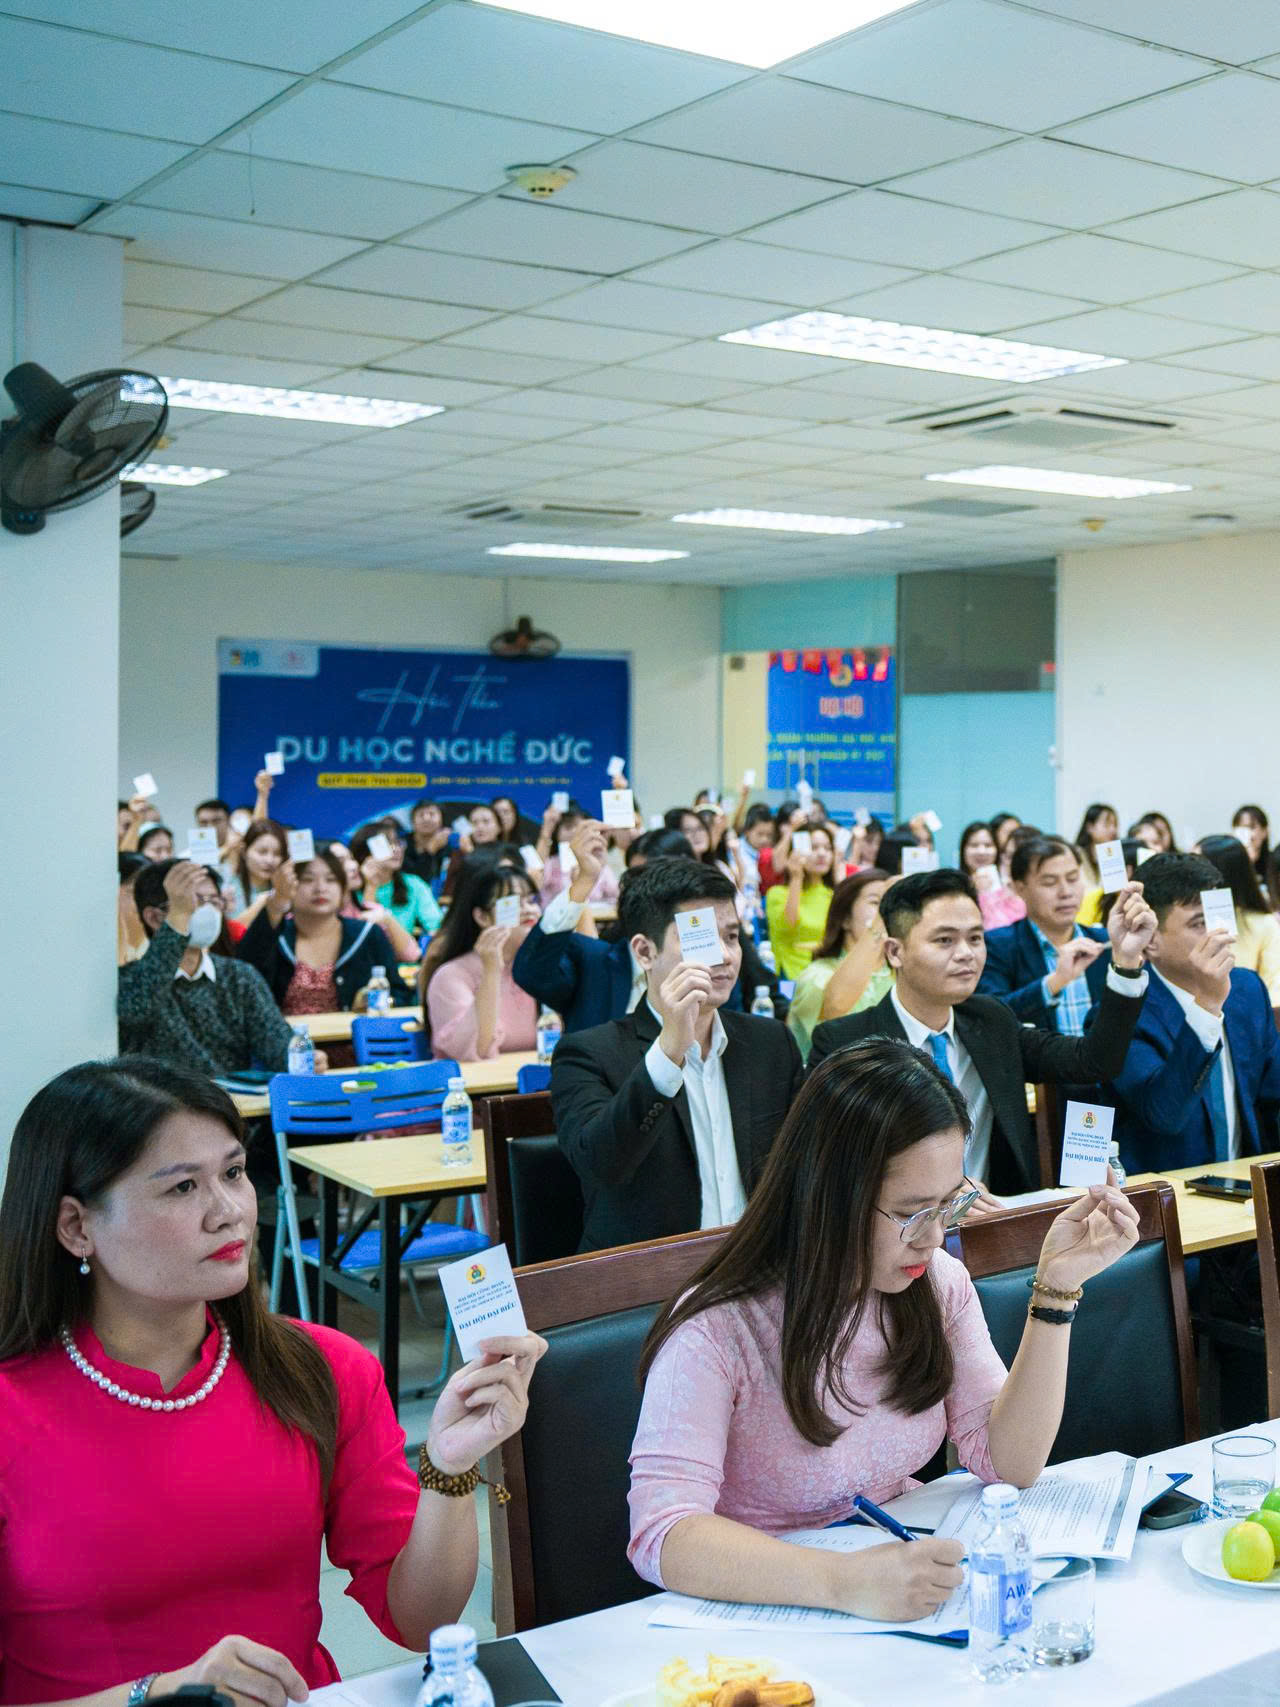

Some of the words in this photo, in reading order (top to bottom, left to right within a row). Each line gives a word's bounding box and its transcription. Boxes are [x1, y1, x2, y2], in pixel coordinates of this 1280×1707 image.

[276, 735, 328, 763] DU
[338, 736, 414, 770] HỌC
[524, 733, 593, 764] ĐỨC
